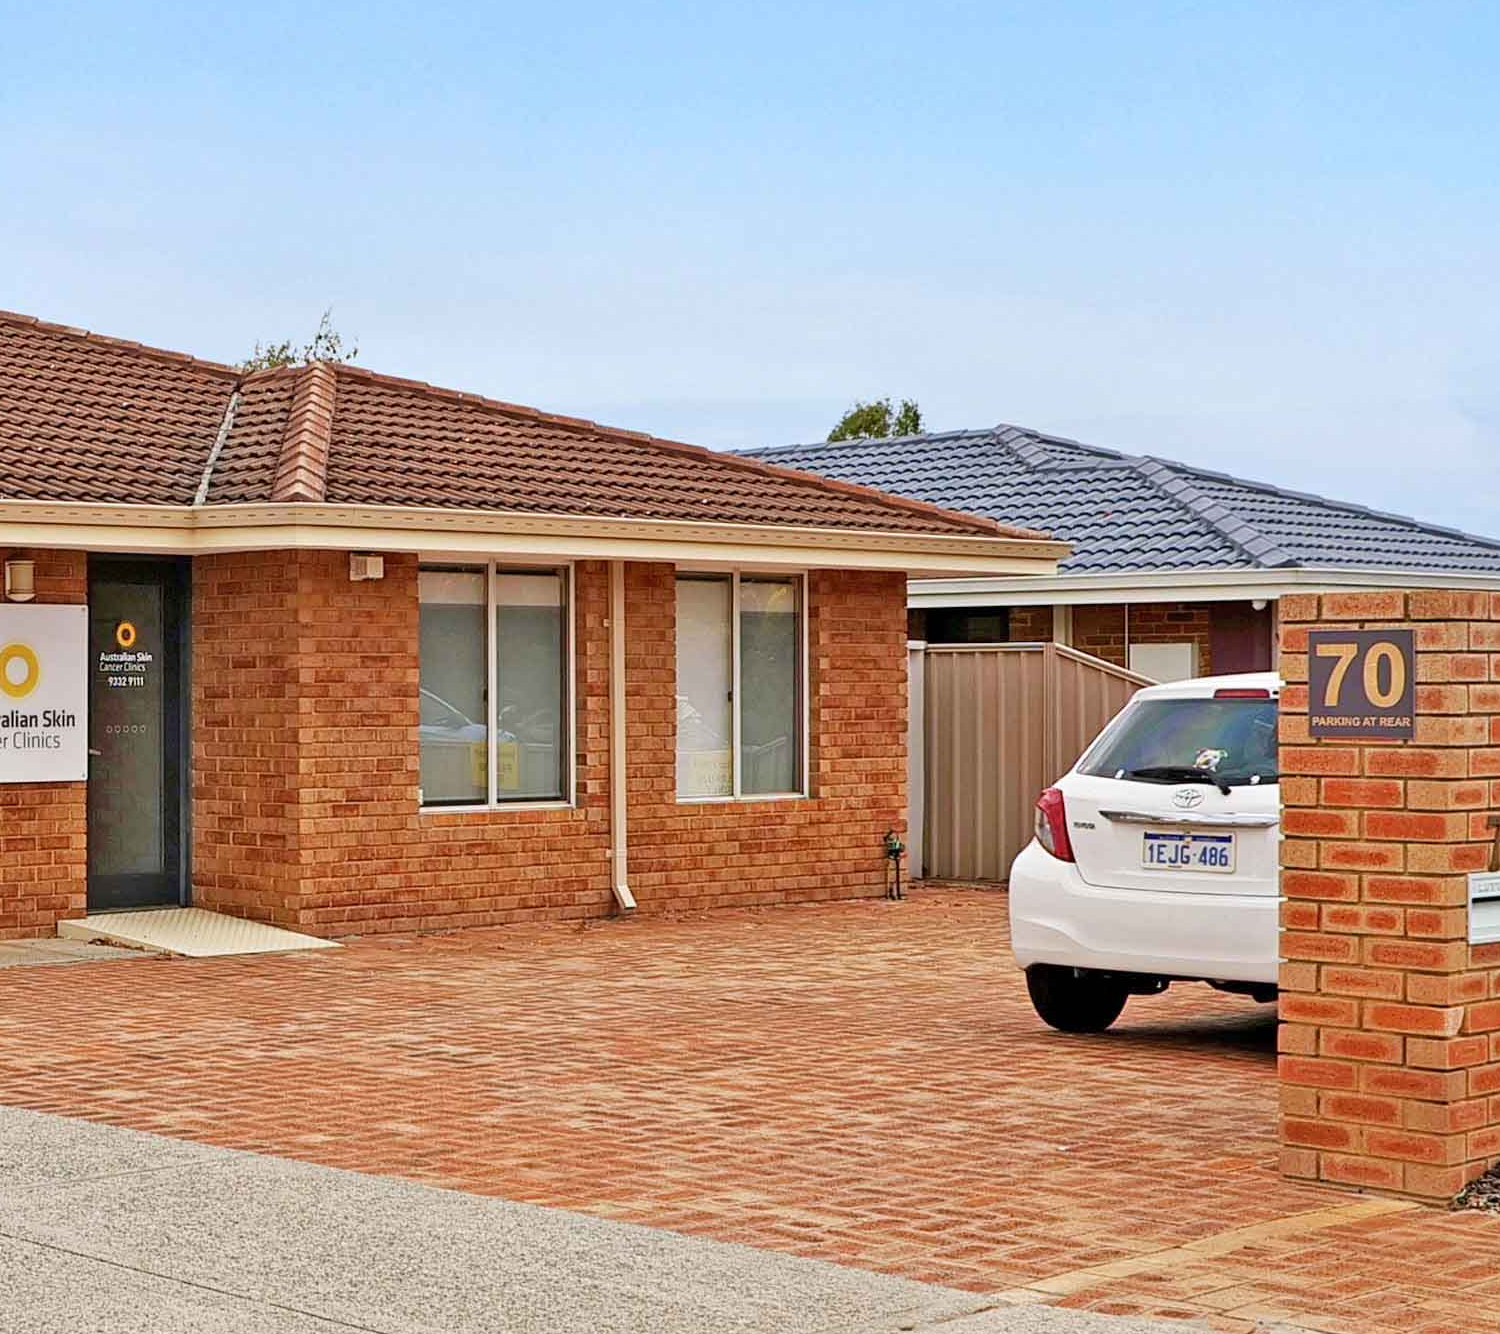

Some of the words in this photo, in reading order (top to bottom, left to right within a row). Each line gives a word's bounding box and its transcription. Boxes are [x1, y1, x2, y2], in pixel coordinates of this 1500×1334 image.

[99, 652, 136, 662] Australian
[137, 652, 153, 662] Skin
[99, 662, 122, 672] Cancer
[124, 662, 146, 672] Clinics
[1316, 641, 1406, 708] 70
[108, 676, 127, 686] 9332
[128, 676, 144, 686] 9111
[42, 709, 76, 728] Skin
[1312, 716, 1360, 727] PARKING
[1362, 716, 1377, 727] AT
[1379, 716, 1412, 727] REAR
[13, 731, 61, 749] Clinics
